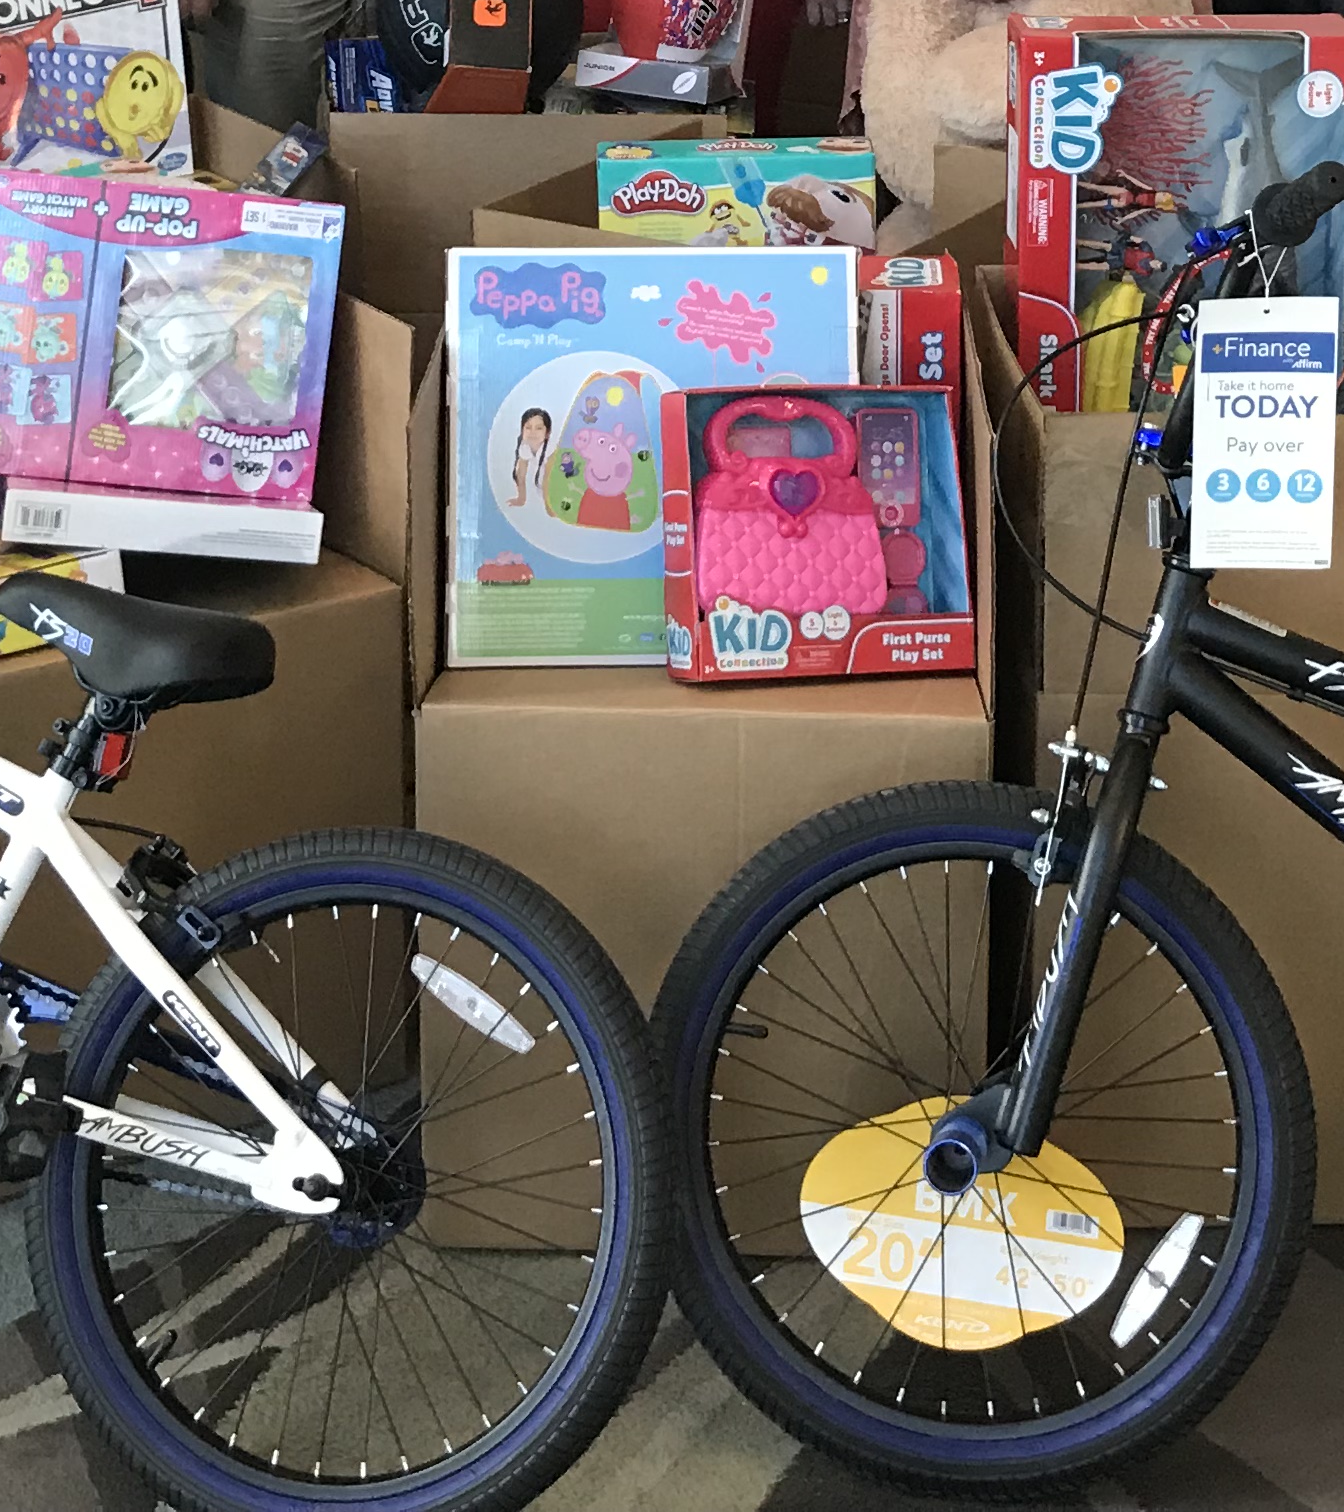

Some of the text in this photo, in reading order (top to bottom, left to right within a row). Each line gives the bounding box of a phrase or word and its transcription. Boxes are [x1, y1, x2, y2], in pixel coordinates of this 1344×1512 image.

[584, 62, 615, 72] JUNIOR
[1034, 51, 1045, 66] 3+
[1034, 79, 1045, 162] Connection
[1051, 71, 1099, 168] KID
[11, 190, 87, 208] MATCH GAME
[129, 192, 190, 214] GAME
[614, 179, 701, 210] Play-Doh
[23, 203, 75, 219] MEMORY
[244, 210, 260, 223] SET
[1038, 199, 1047, 244] WARNING:
[116, 214, 199, 239] POP-UP
[888, 259, 926, 285] KID
[477, 271, 604, 320] Peppa Pig
[881, 304, 891, 341] Opens!
[496, 333, 531, 348] Camp
[548, 333, 571, 348] Play
[1224, 337, 1311, 358] Finance
[881, 345, 889, 371] Door
[919, 333, 943, 380] Set
[1218, 380, 1294, 391] Take it home
[1215, 395, 1318, 418] TODAY
[1227, 437, 1304, 456] Pay over
[1217, 473, 1315, 492] 3 6 12
[669, 627, 690, 656] KID
[713, 614, 789, 655] KID
[882, 632, 951, 645] First Purse
[720, 657, 785, 668] Connection
[891, 649, 944, 664] Play Set
[167, 993, 219, 1053] KENT
[79, 1113, 210, 1167] AMBUSH
[915, 1181, 1018, 1227] BMX
